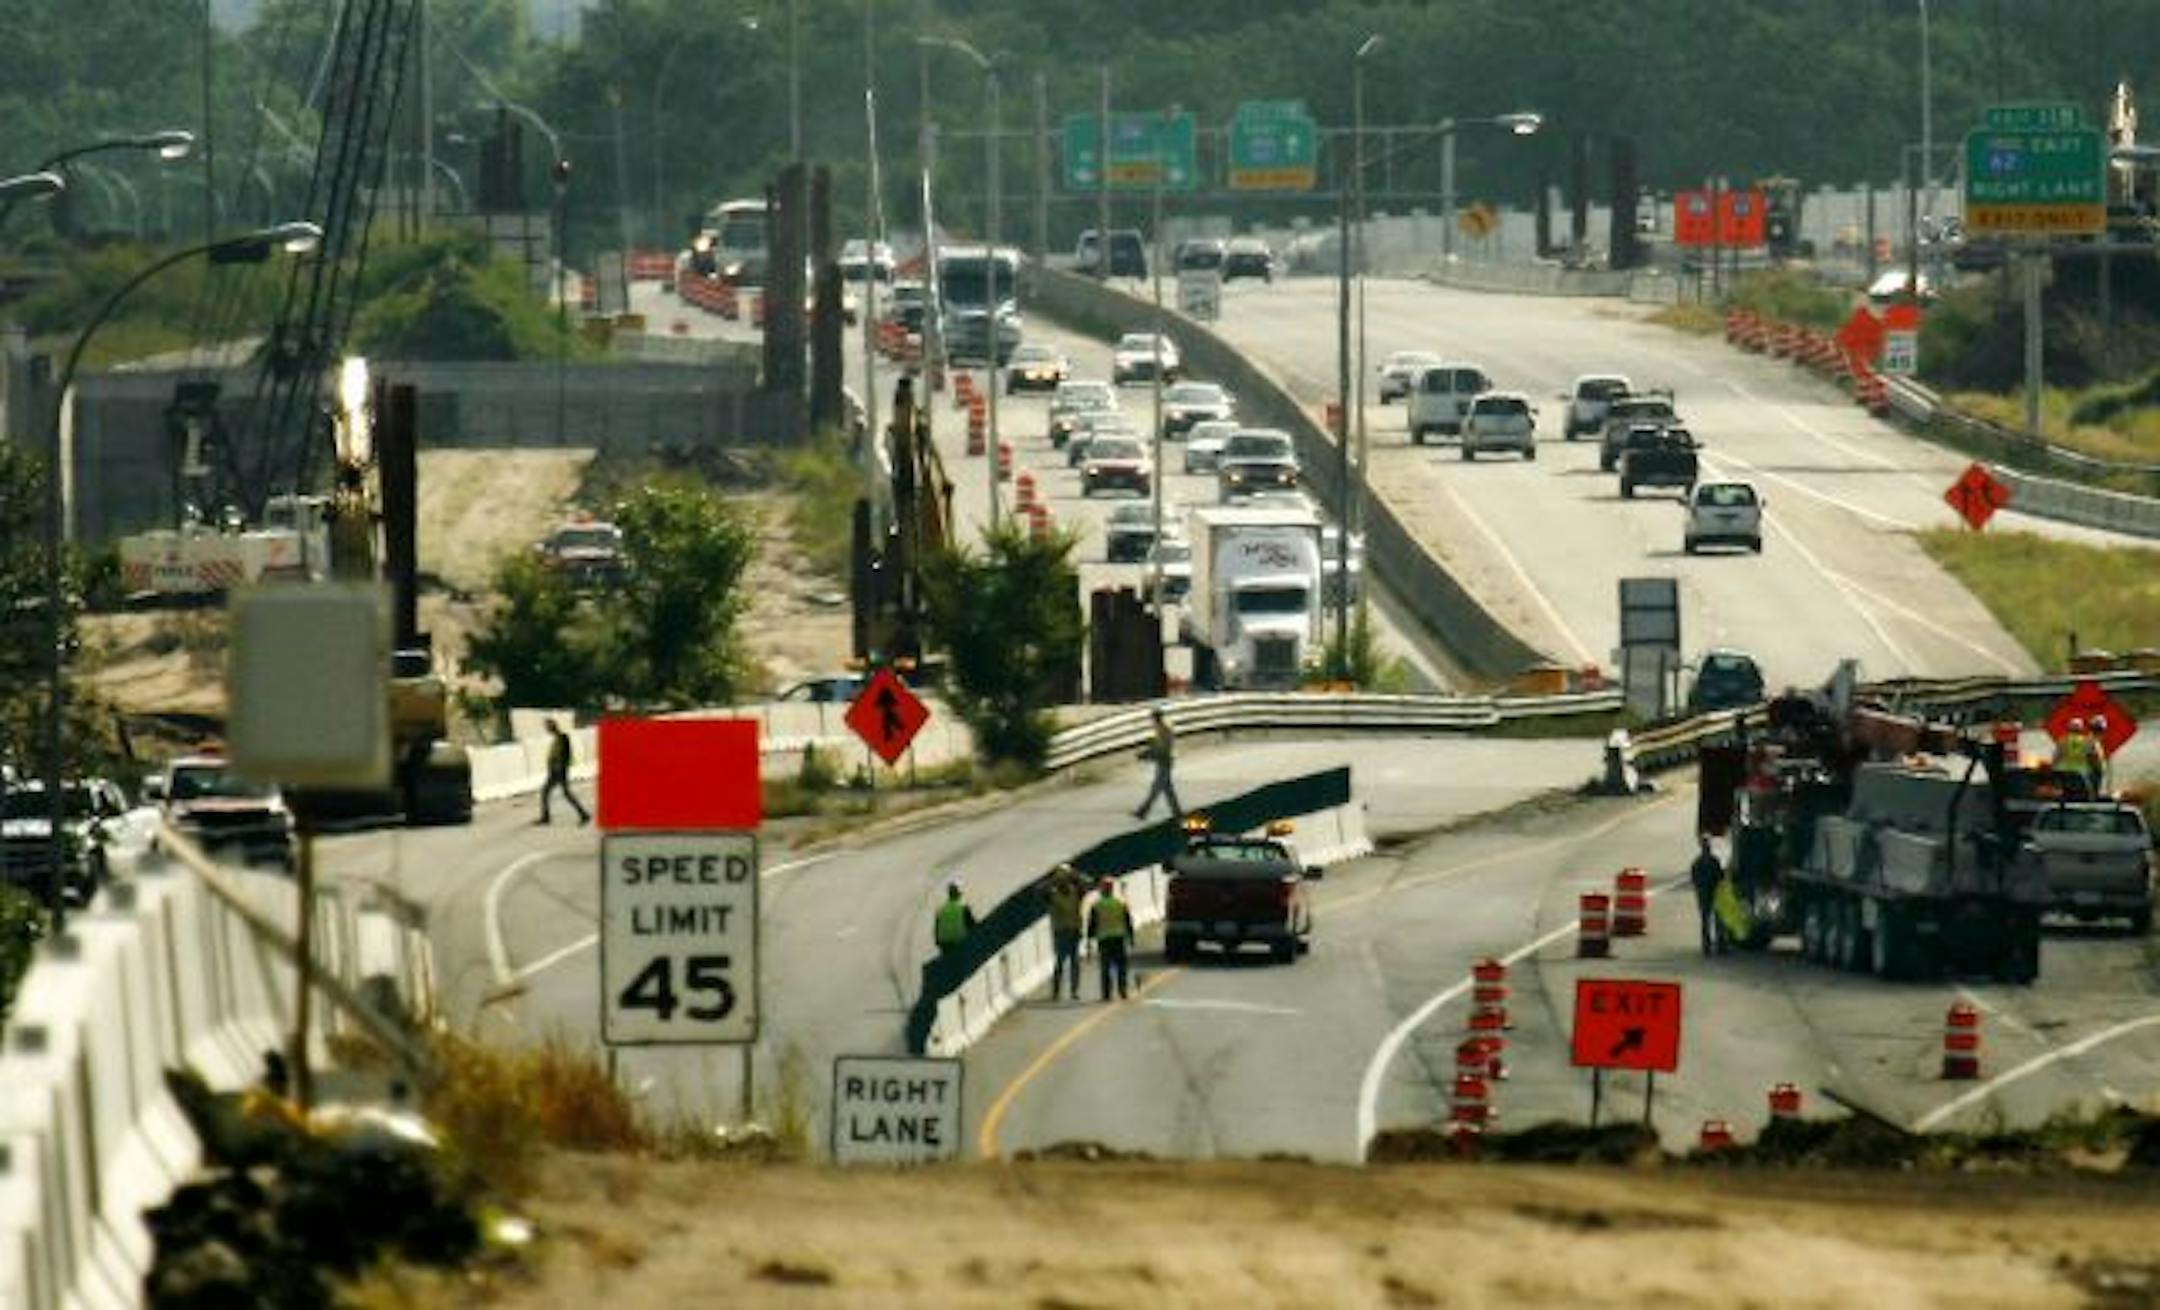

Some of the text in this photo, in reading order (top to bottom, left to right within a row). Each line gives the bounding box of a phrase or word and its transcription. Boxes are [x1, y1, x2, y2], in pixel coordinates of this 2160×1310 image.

[1972, 180, 2095, 198] RIGHT LANE
[1978, 210, 2026, 227] EXIT
[621, 854, 749, 886] SPEED
[631, 904, 735, 936] LIMIT
[616, 955, 737, 1023] 45
[1590, 990, 1667, 1015] EXIT
[845, 1076, 948, 1104] RIGHT
[850, 1113, 942, 1146] LANE
